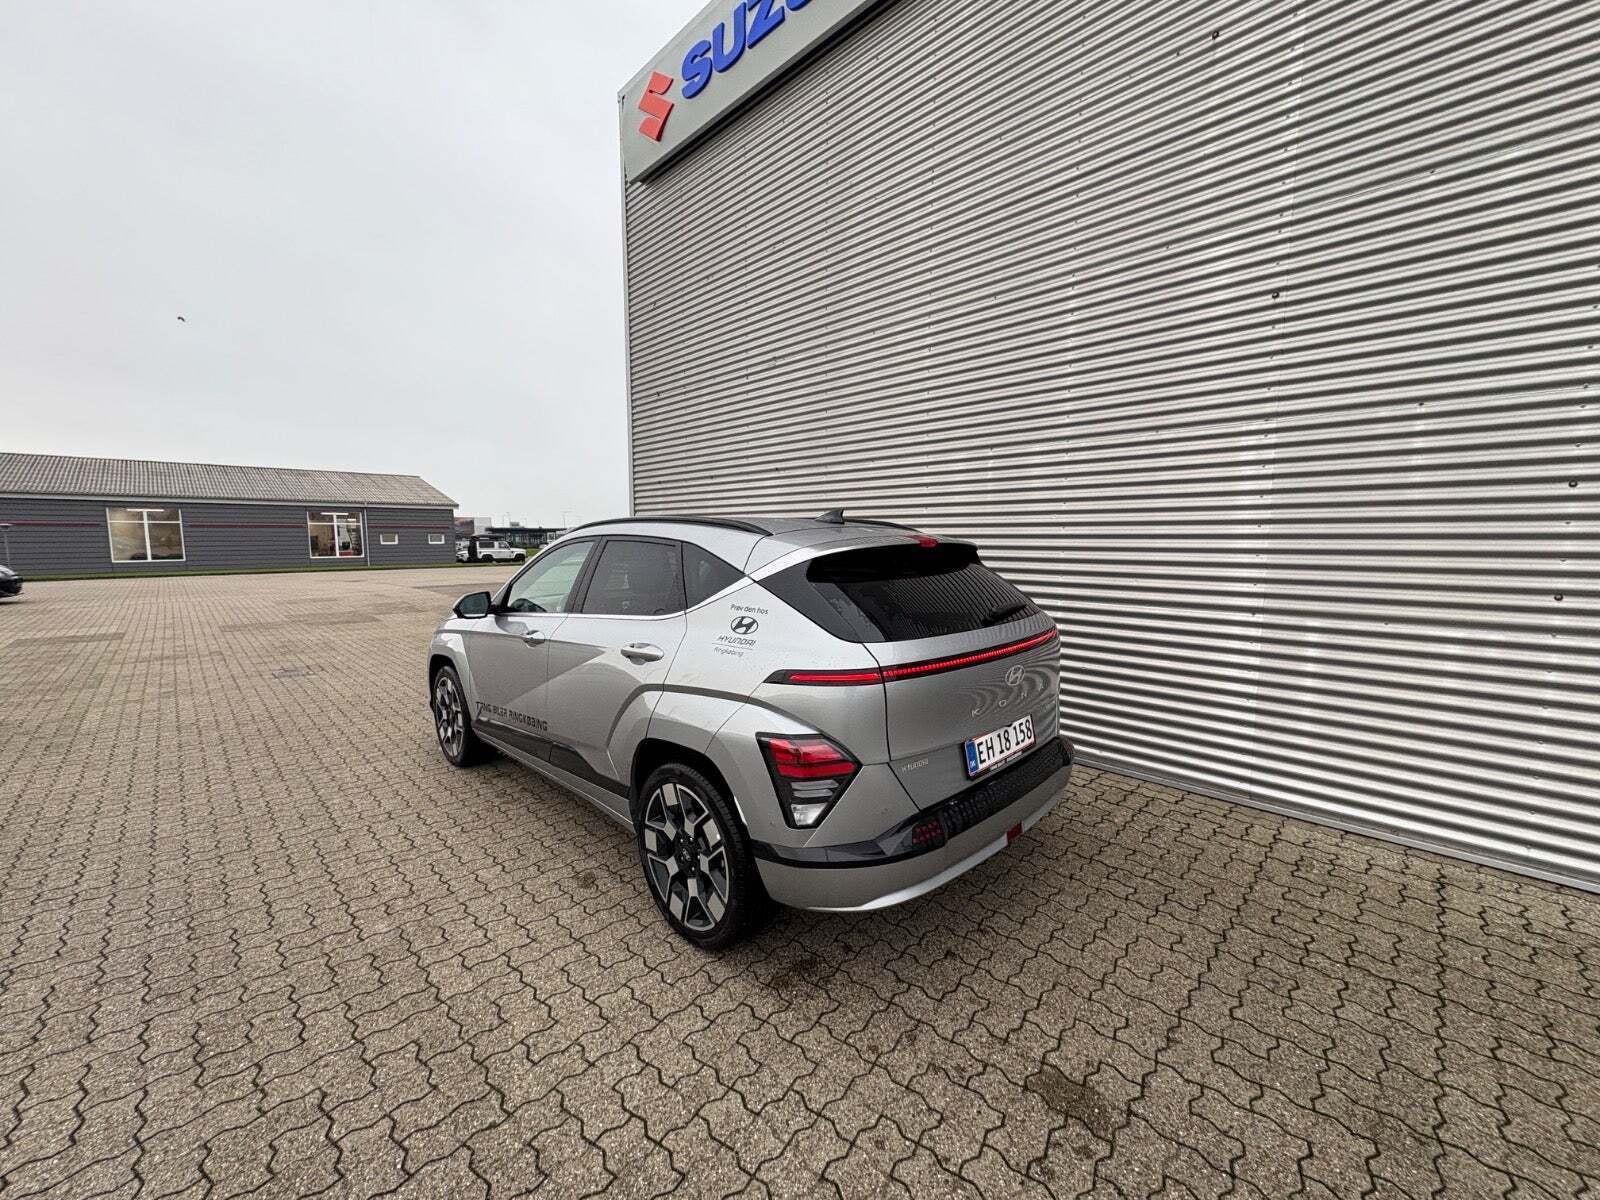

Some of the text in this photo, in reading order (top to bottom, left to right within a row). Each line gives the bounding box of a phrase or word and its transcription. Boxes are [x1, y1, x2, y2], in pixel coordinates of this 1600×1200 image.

[681, 0, 812, 99] SUZ
[744, 605, 756, 613] den
[757, 606, 769, 615] hos
[716, 634, 757, 647] HYUNDAI
[976, 738, 995, 764] EH
[998, 729, 1012, 754] 18
[1012, 718, 1033, 746] 158
